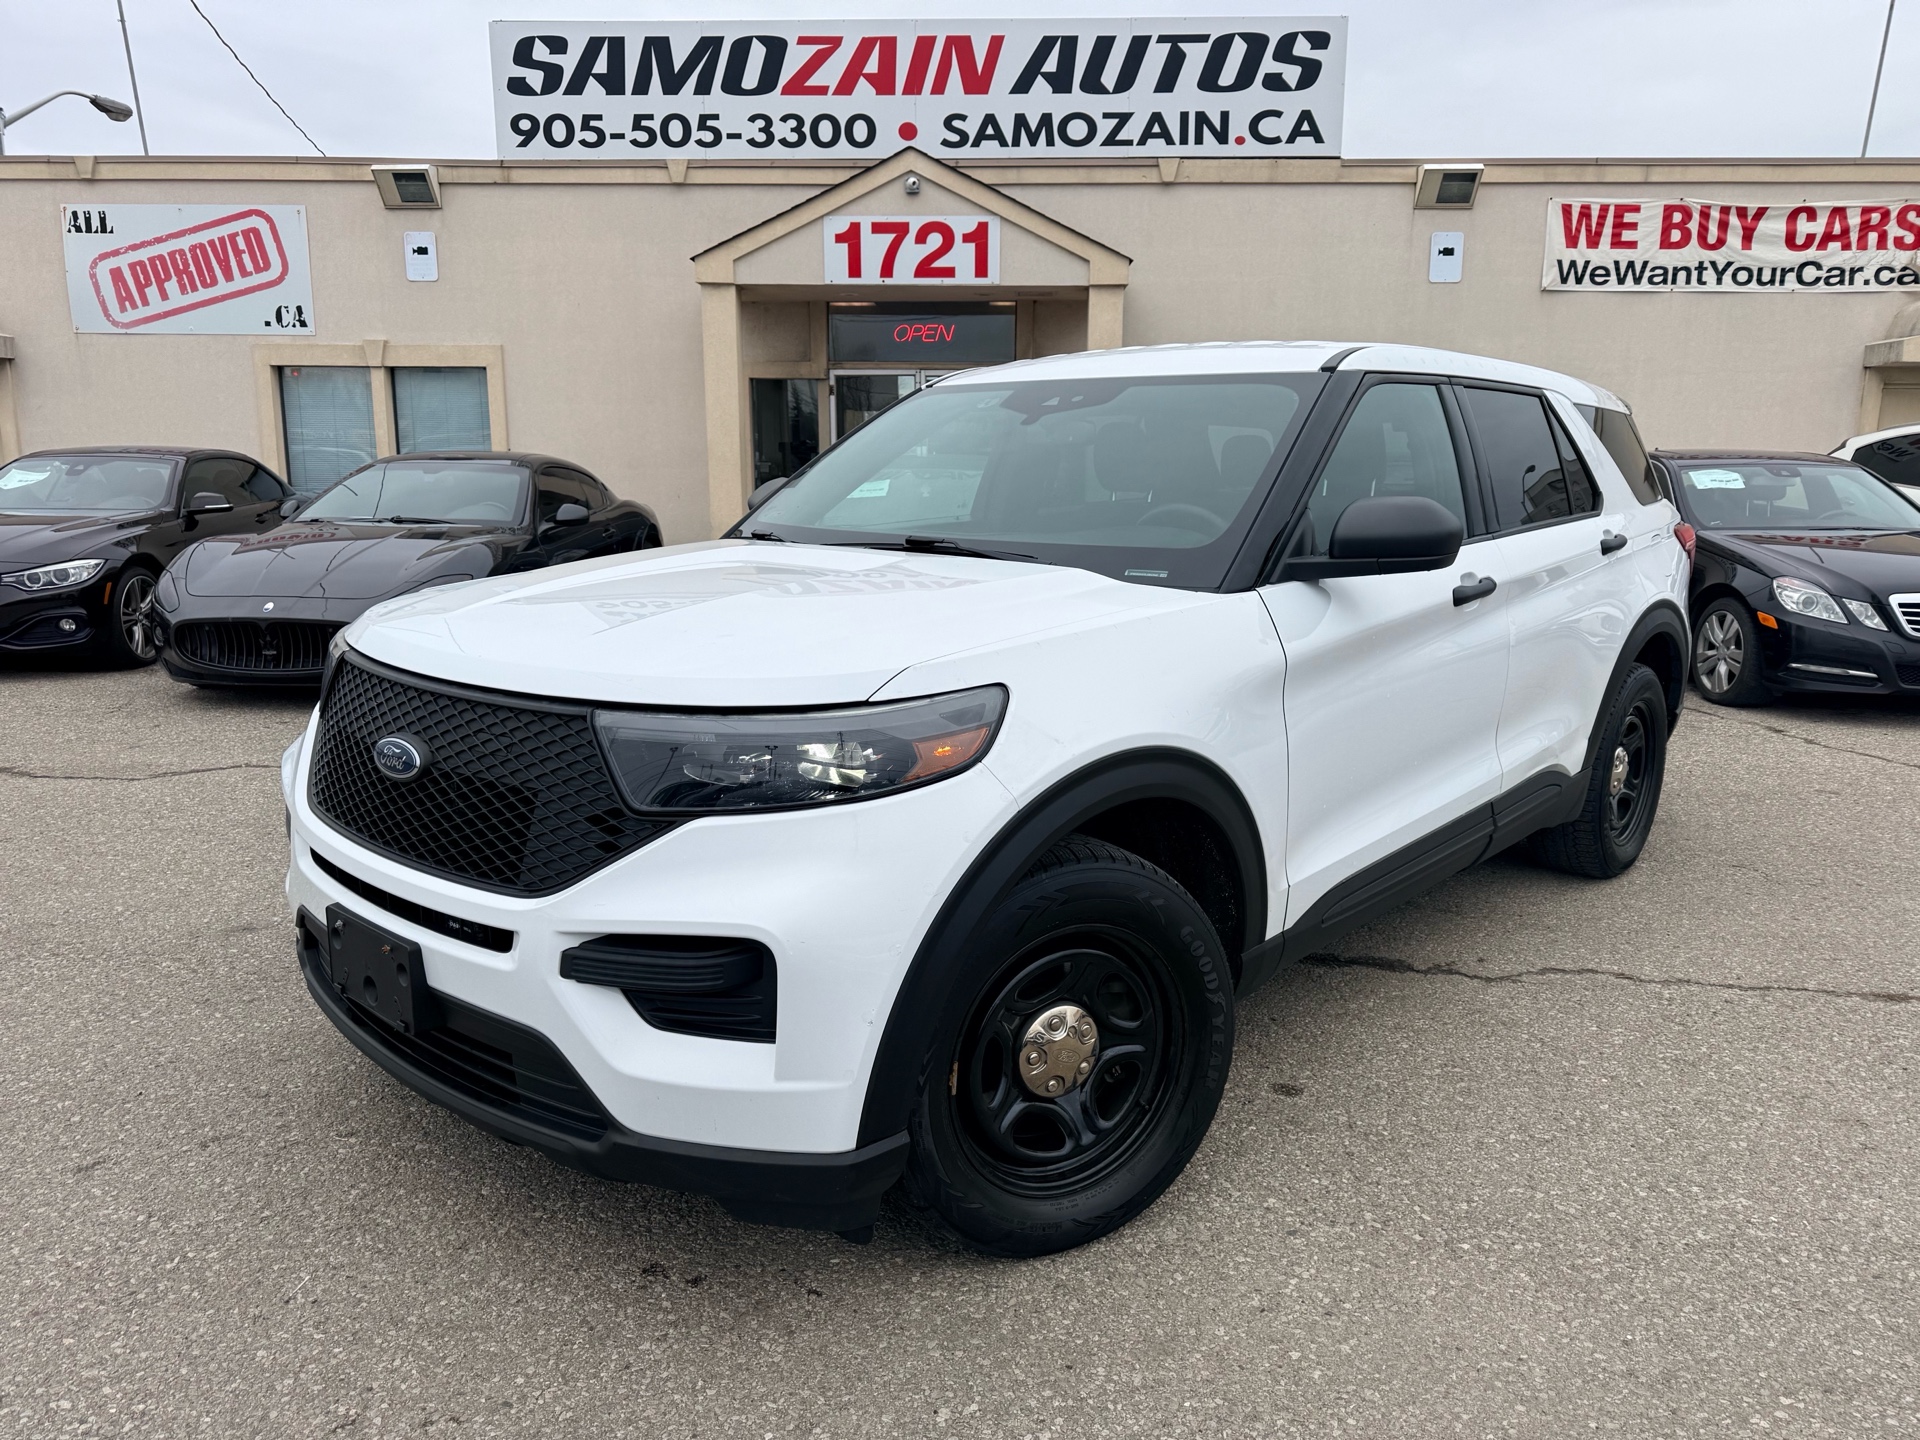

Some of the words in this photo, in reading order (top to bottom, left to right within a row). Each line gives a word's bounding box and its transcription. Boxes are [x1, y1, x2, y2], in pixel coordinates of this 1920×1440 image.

[507, 36, 1005, 96] SAMOZAIN
[1008, 30, 1331, 95] AUTOS
[509, 112, 877, 149] 905-505-3300
[940, 109, 1325, 149] SAMOZAIN.CA
[67, 210, 114, 234] ALL
[1560, 203, 1642, 250] WE
[1658, 203, 1769, 252] BUY
[1784, 203, 1920, 252] CARS
[834, 221, 989, 279] 1721
[109, 226, 272, 314] APPROVED
[1556, 259, 1920, 287] WeWantYourCar.ca
[264, 304, 309, 329] .CA
[893, 323, 956, 343] OPEN
[380, 744, 407, 770] Ford
